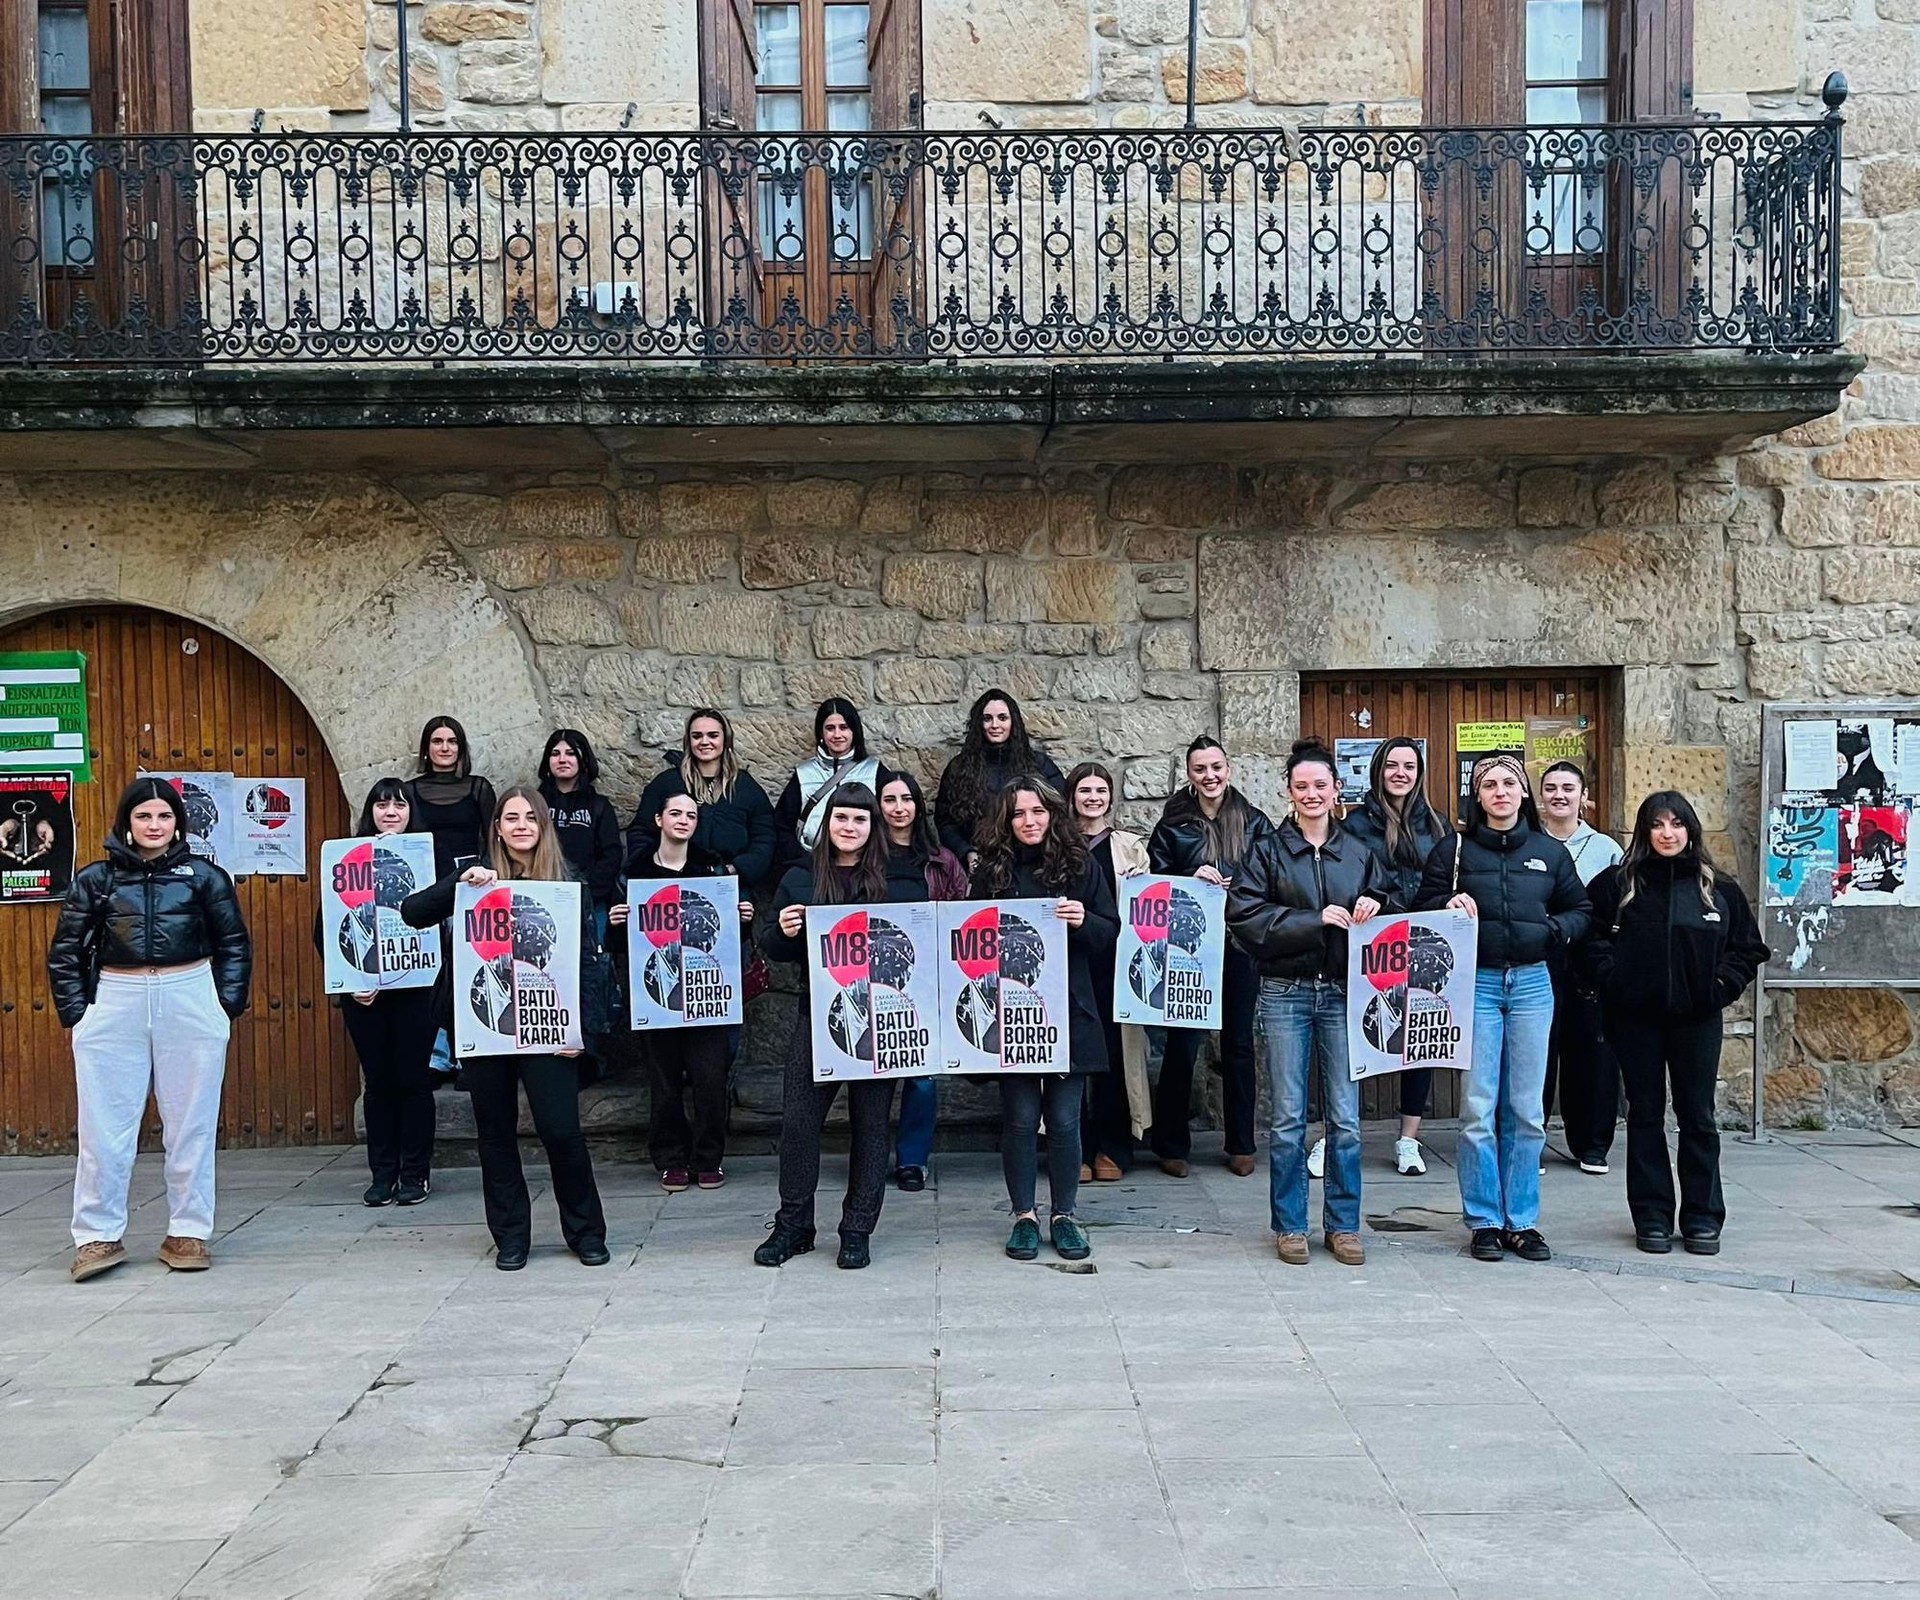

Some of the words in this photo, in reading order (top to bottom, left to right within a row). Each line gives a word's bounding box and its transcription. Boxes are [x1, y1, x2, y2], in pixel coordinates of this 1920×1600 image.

[8, 686, 80, 699] EUSKALTZALE
[1533, 735, 1586, 748] ESKUTIK
[1535, 746, 1585, 758] ESKURA
[2, 877, 50, 887] PALESTINA
[332, 862, 373, 893] 8M
[638, 902, 679, 932] M8
[1129, 897, 1167, 927] M8
[464, 908, 510, 942] M8
[401, 937, 420, 953] LA
[820, 931, 867, 968] M8
[950, 928, 997, 961] M8
[382, 952, 436, 972] LUCHA!
[1361, 940, 1408, 975] M8
[685, 969, 720, 986] BATU
[1168, 970, 1201, 987] BATU
[518, 989, 555, 1007] BATU
[686, 985, 732, 1002] BORRO
[1167, 986, 1212, 1005] BORRO
[519, 1008, 569, 1026] BORRO
[686, 1001, 728, 1019] KARA!
[1004, 1007, 1043, 1025] BATU
[1167, 1003, 1207, 1020] KARA!
[1409, 1010, 1447, 1028] BATU
[876, 1010, 914, 1031] BATU
[520, 1027, 566, 1045] KARA!
[877, 1028, 929, 1050] BORRO
[1004, 1026, 1057, 1044] BORRO
[1408, 1026, 1461, 1045] BORRO
[877, 1048, 925, 1069] KARA!
[1004, 1046, 1052, 1064] KARA!
[1407, 1043, 1454, 1061] KARA!
